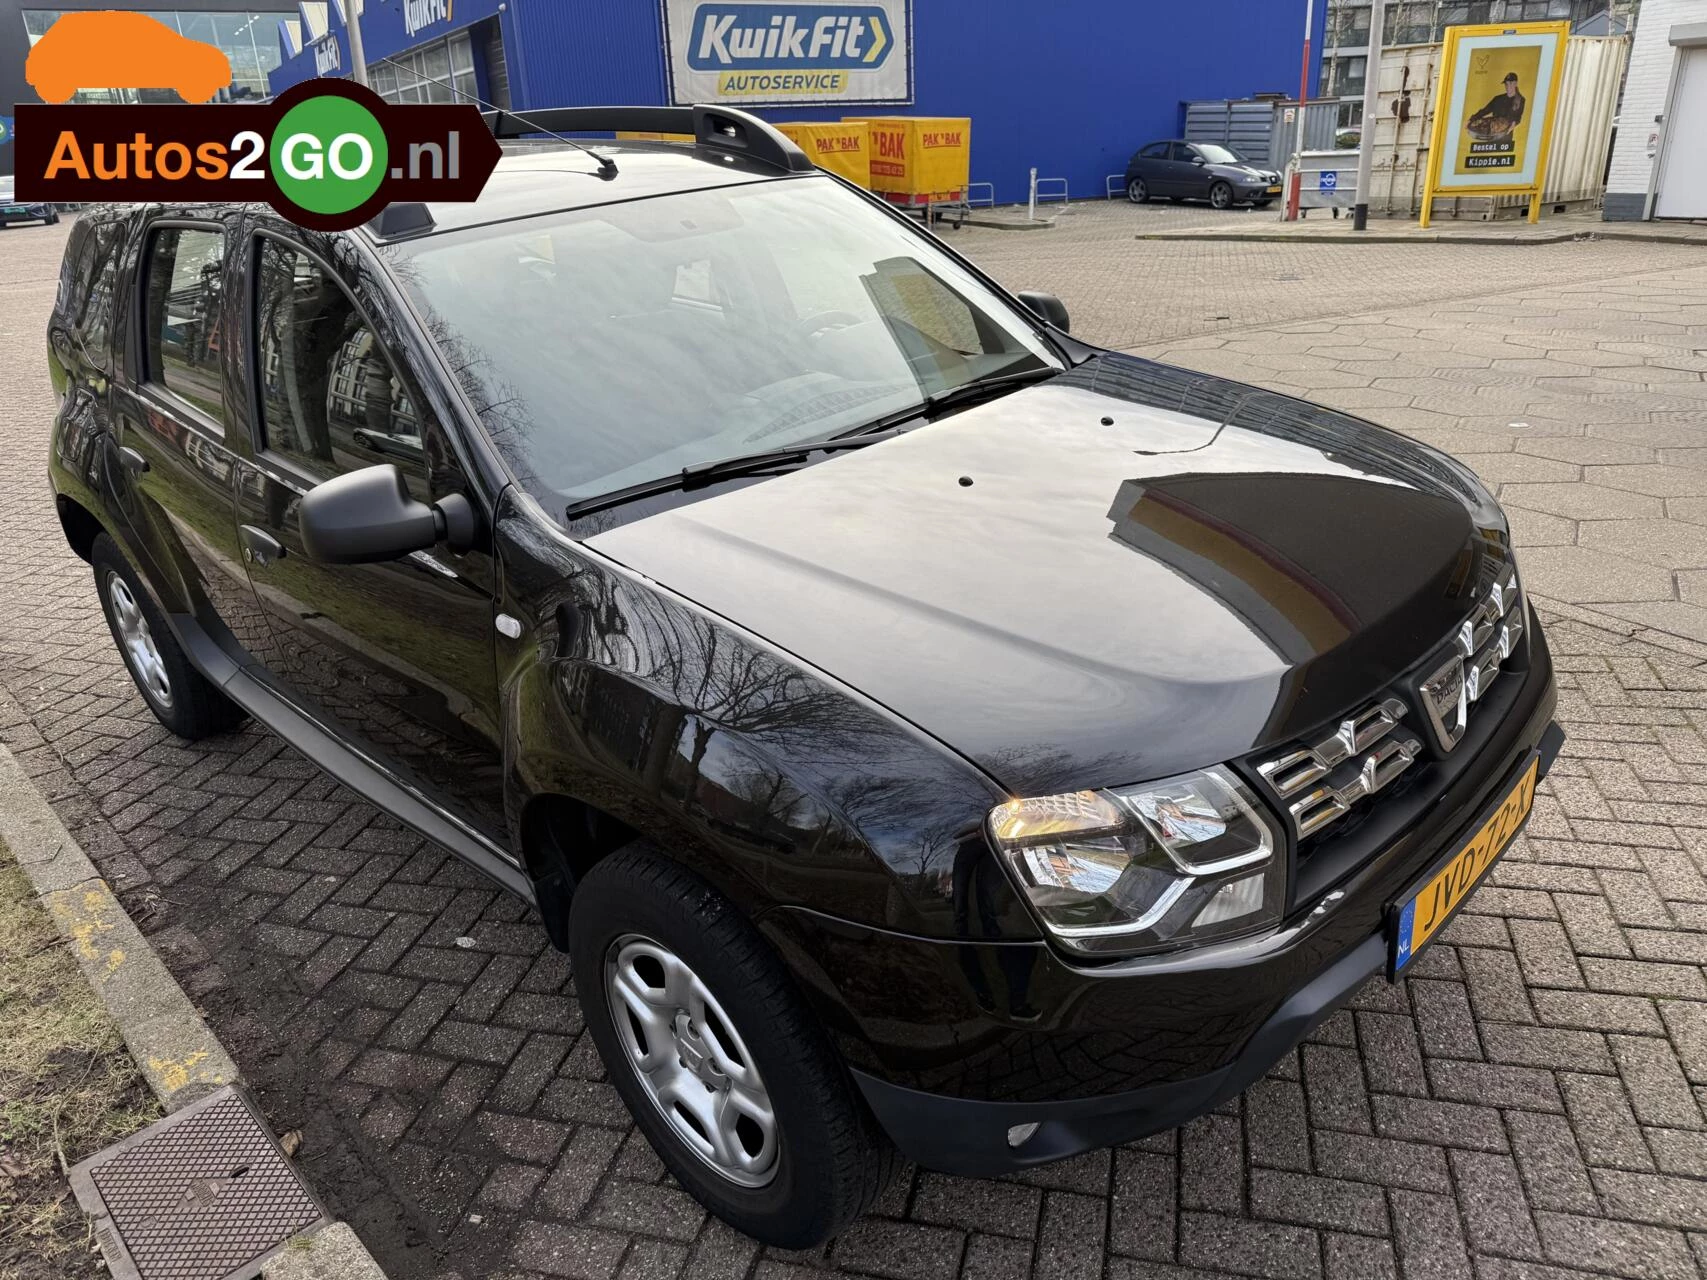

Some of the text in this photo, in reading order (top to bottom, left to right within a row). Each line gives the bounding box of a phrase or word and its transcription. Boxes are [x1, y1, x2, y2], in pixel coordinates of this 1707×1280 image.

[725, 74, 841, 91] AUTOSERVICE
[816, 137, 834, 151] PAK
[841, 135, 860, 150] BAK
[879, 131, 905, 160] BAK
[923, 133, 940, 146] PAK
[945, 131, 961, 145] BAK
[1472, 143, 1510, 151] Bestel op
[1468, 157, 1511, 167] Kippie.nl
[1436, 673, 1463, 704] DACIA
[1397, 941, 1410, 958] NL
